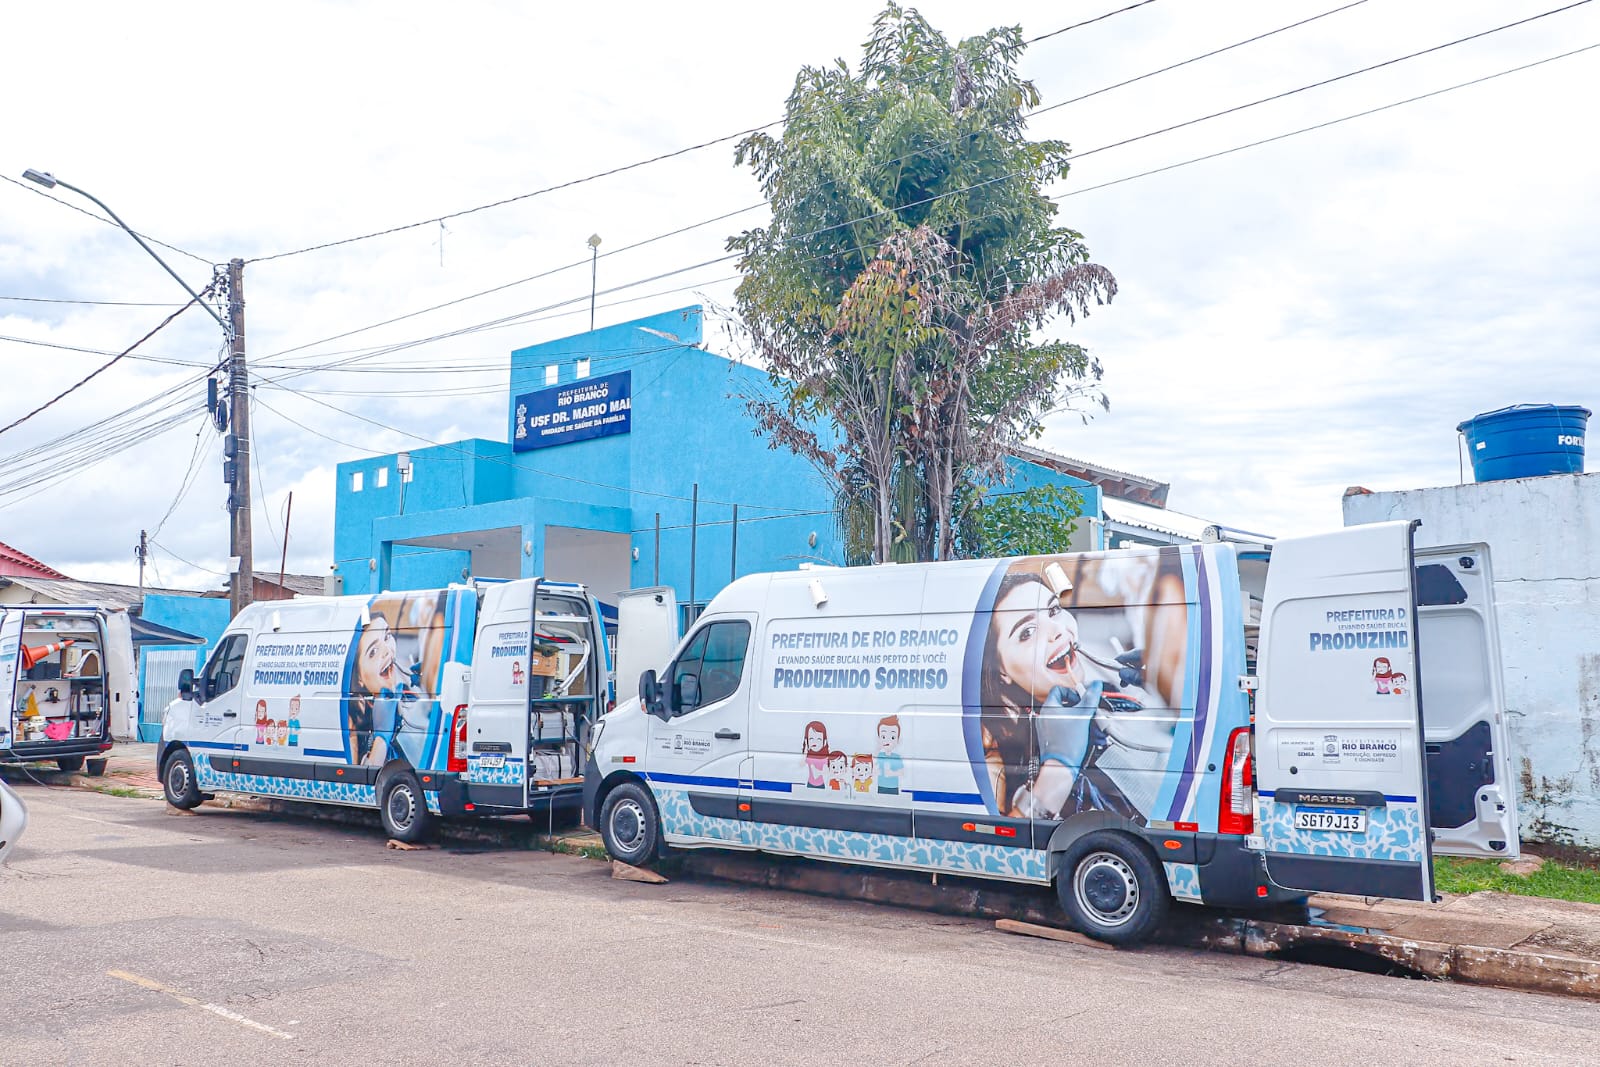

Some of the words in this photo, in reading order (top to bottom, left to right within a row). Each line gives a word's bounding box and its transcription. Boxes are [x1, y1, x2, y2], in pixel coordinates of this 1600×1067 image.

[558, 384, 597, 397] PREFEITURA
[558, 396, 572, 407] RIO
[574, 388, 608, 403] BRANCO
[530, 414, 551, 428] USF
[552, 411, 570, 424] DR.
[572, 402, 607, 420] MARIO
[609, 397, 631, 413] MAI
[541, 426, 565, 436] UNIDADE
[566, 424, 573, 432] DE
[574, 420, 594, 430] SAÚDE
[594, 418, 602, 426] DA
[603, 414, 626, 425] FAMÍLIA
[1326, 608, 1395, 623] PREFEITURA
[1338, 623, 1366, 631] LEVANDO
[1366, 621, 1386, 630] SAÚDE
[771, 631, 849, 649] PREFEITURA
[851, 631, 870, 649] DE
[872, 630, 896, 648] RIO
[899, 629, 959, 647] BRANCO
[1309, 630, 1409, 651] PRODUZIND
[255, 645, 294, 657] PREFEITURA
[294, 644, 305, 656] DE
[305, 644, 318, 656] RIO
[318, 643, 347, 656] BRANCO
[777, 654, 810, 665] LEVANDO
[811, 653, 835, 665] SAÚDE
[836, 654, 860, 664] BUCAL
[862, 654, 881, 664] MAIS
[882, 654, 908, 664] PERTO
[910, 654, 921, 663] DE
[922, 652, 947, 663] VOCÊ!
[254, 670, 302, 685] PRODUZINDO
[303, 670, 339, 686] SORRISO
[773, 668, 870, 689] PRODUZINDO
[875, 667, 948, 690] SORRISO
[1359, 743, 1397, 751] BRANCO
[1298, 794, 1356, 804] MASTER
[1301, 813, 1360, 830] SGT9J13
